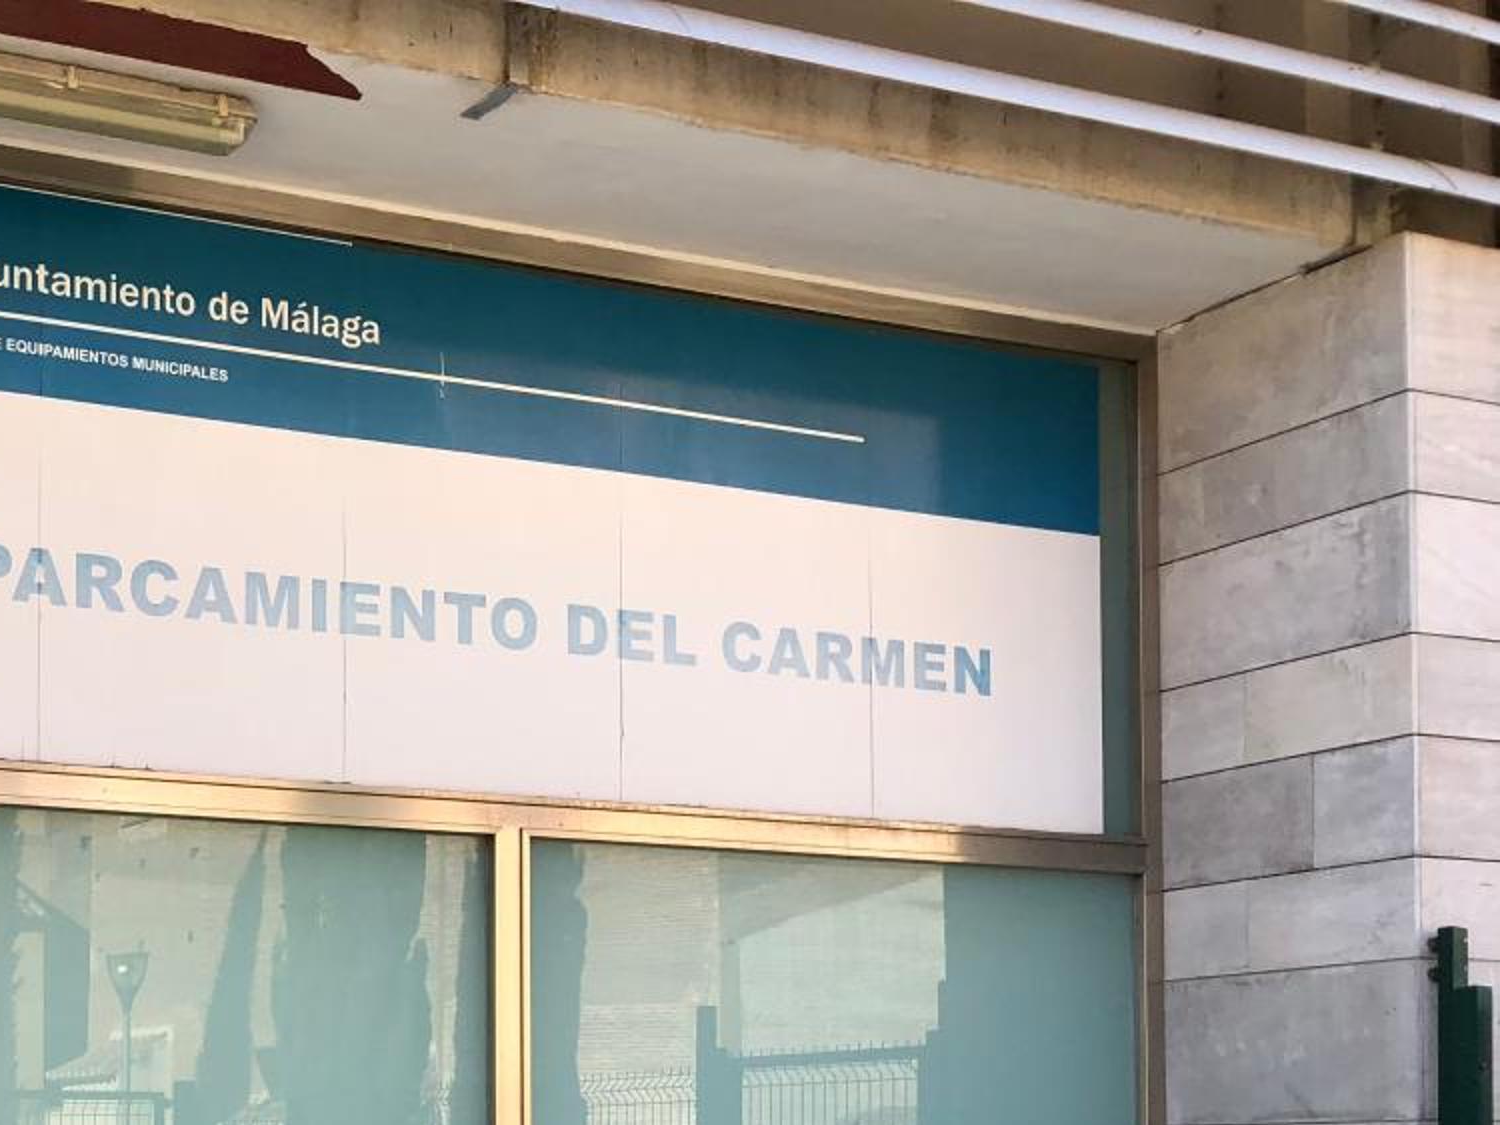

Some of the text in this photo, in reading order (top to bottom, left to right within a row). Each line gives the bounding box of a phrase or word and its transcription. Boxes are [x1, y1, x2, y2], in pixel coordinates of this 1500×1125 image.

[208, 291, 249, 325] de
[260, 296, 380, 348] Málaga
[6, 337, 129, 367] EQUIPAMIENTOS
[131, 357, 229, 382] MUNICIPALES
[566, 603, 696, 666] DEL
[721, 622, 992, 697] CARMEN
